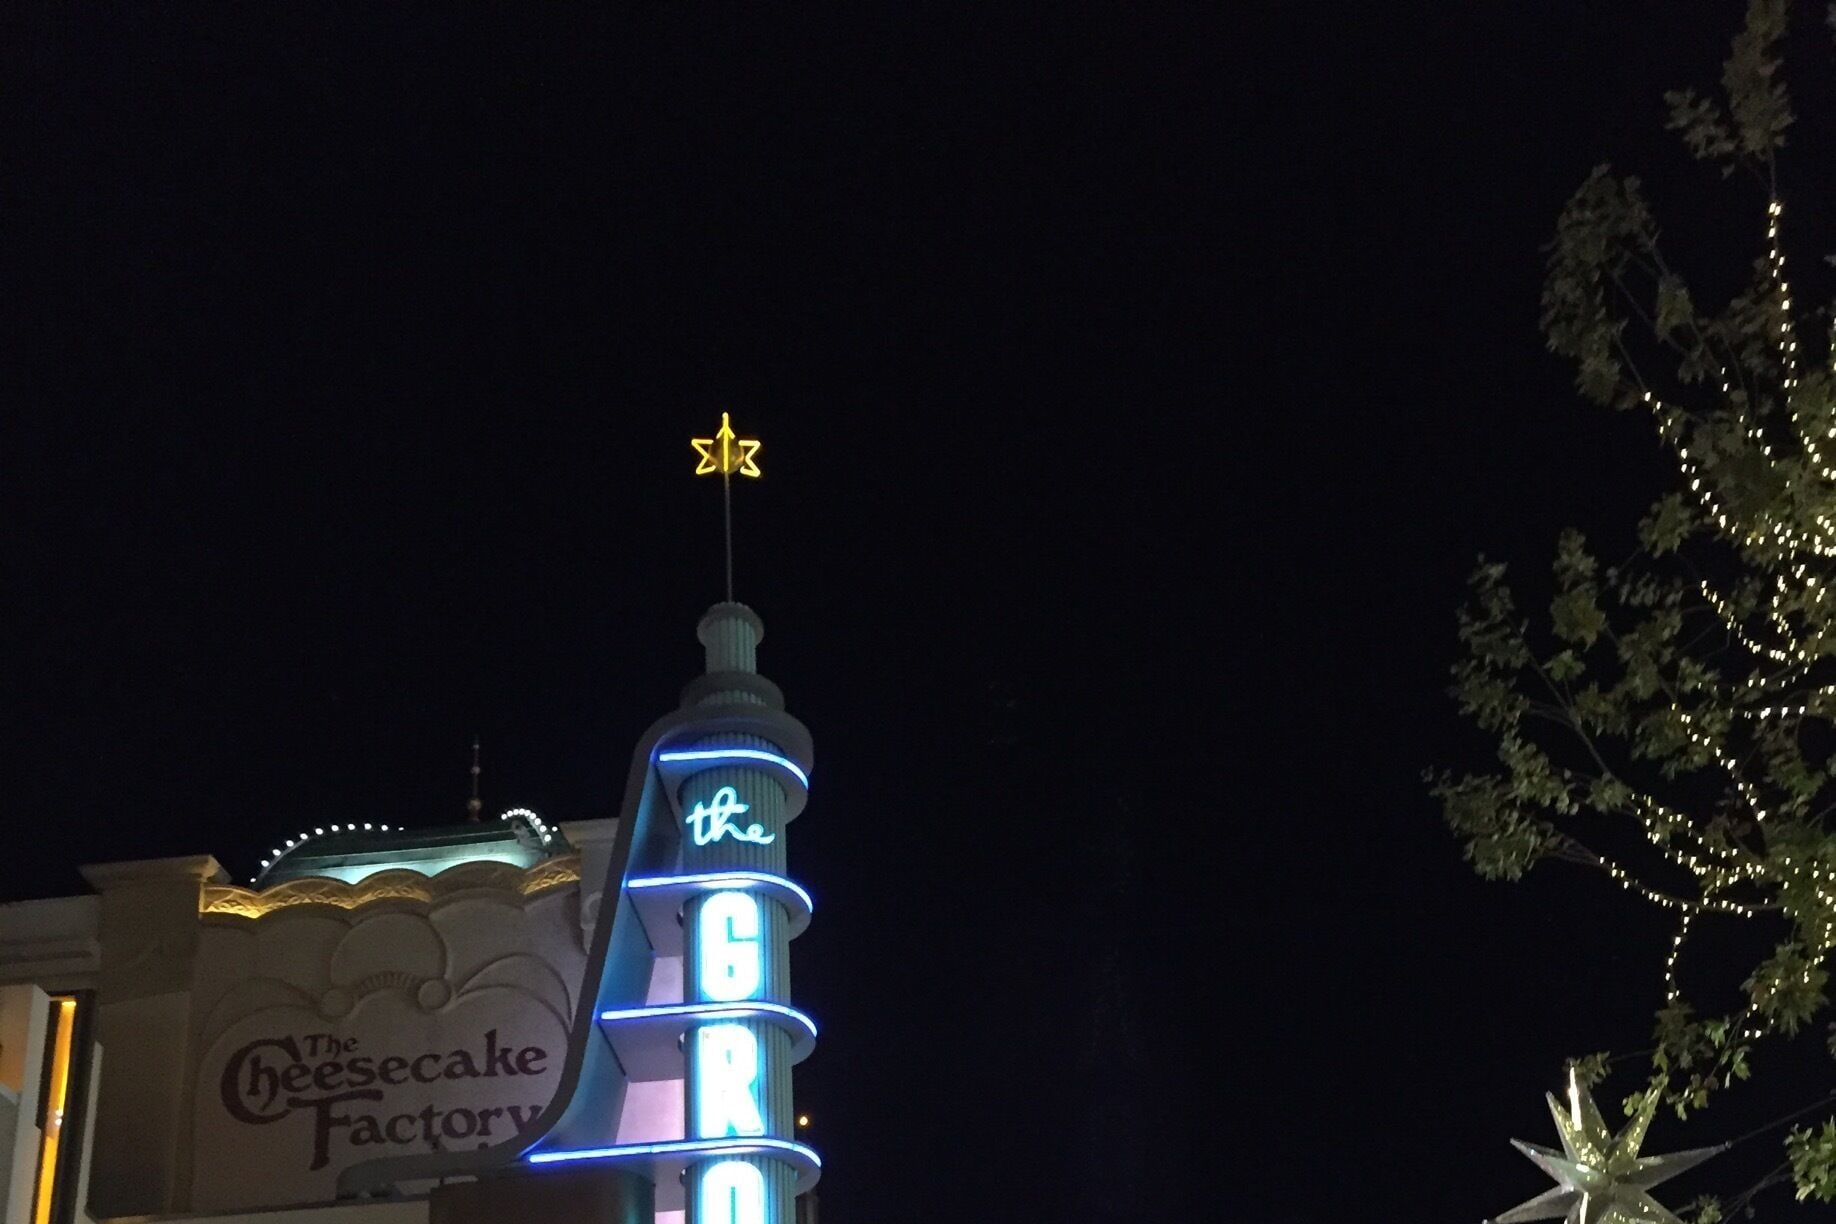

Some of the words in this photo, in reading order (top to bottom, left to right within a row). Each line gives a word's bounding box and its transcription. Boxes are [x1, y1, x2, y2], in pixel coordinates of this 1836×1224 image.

[686, 786, 776, 846] the
[303, 1034, 357, 1057] The
[220, 1028, 548, 1125] Cheesecake
